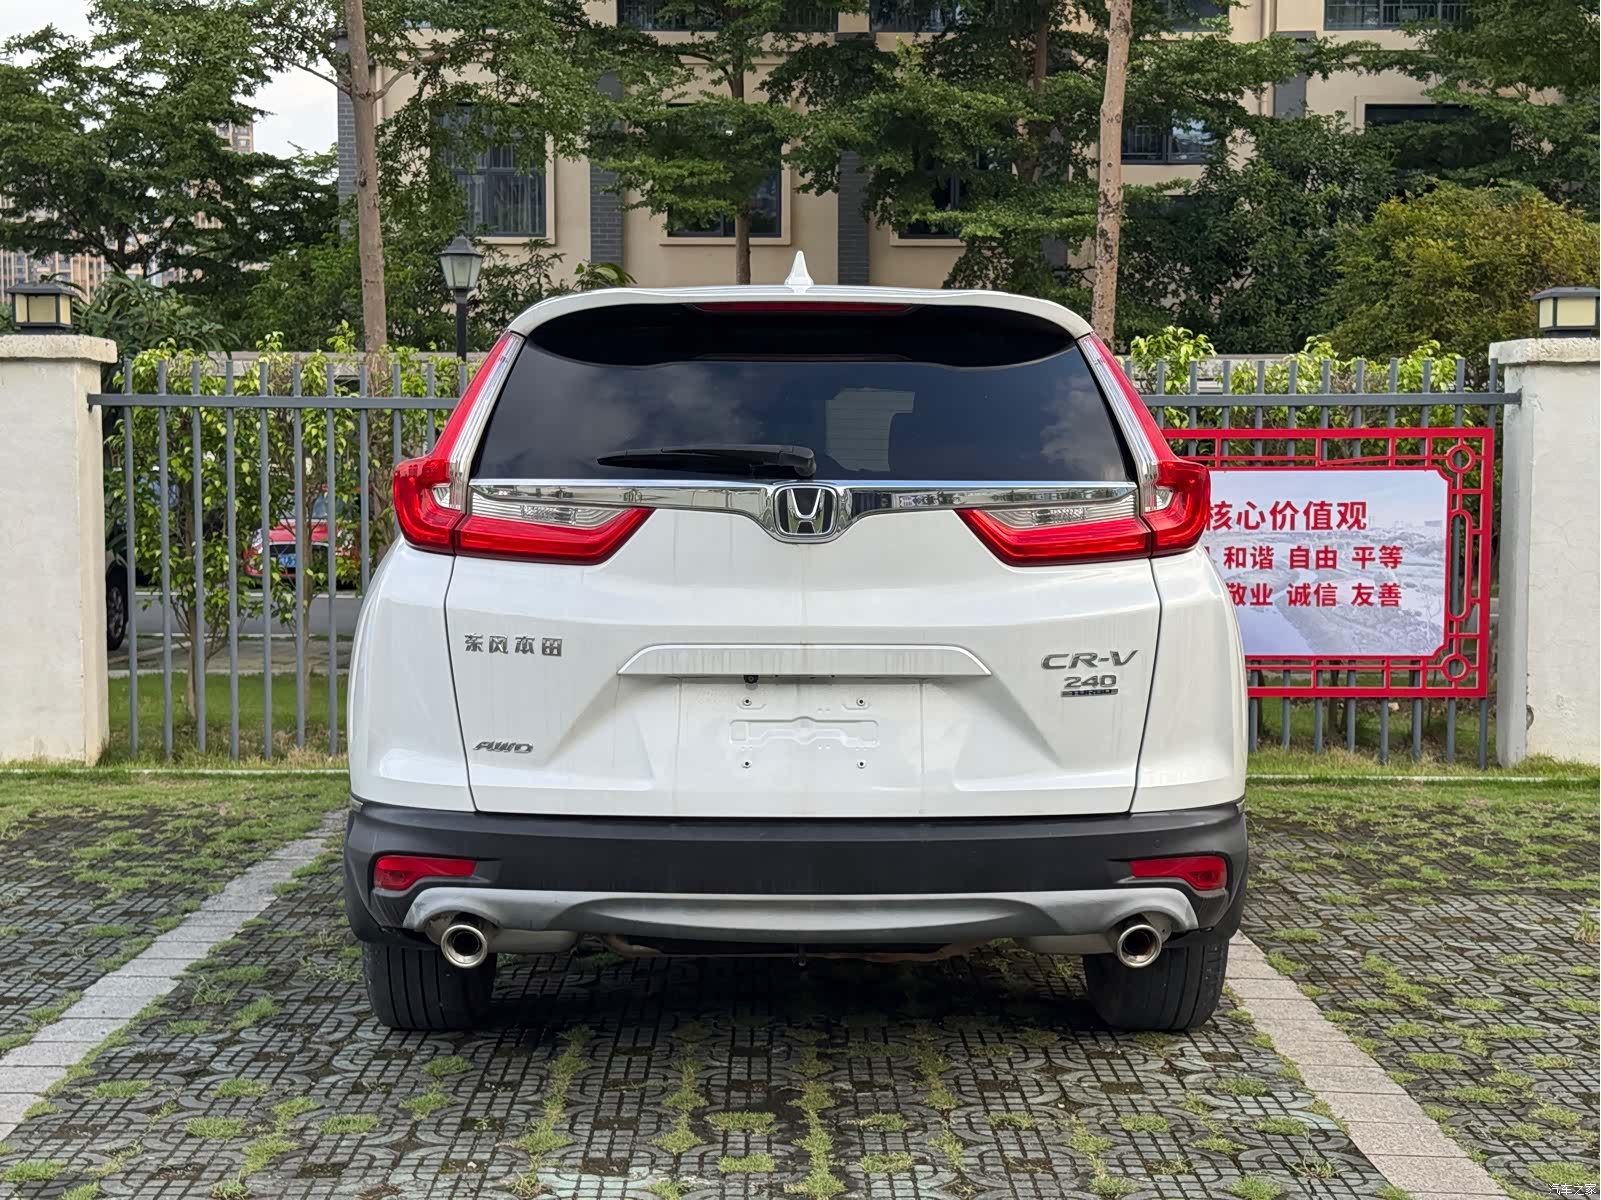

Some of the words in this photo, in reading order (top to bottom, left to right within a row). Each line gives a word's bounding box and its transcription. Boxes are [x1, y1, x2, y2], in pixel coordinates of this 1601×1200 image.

[1206, 500, 1368, 531] 核心价值观
[1223, 545, 1275, 570] 和谐
[1289, 546, 1338, 570] 自由
[1351, 545, 1404, 570] 平等
[1286, 582, 1338, 607] 诚信
[1351, 582, 1403, 607] 友善
[464, 633, 563, 657] 东风本田
[1041, 649, 1140, 670] CR-V
[1063, 674, 1117, 689] 240
[473, 740, 534, 754] AWD
